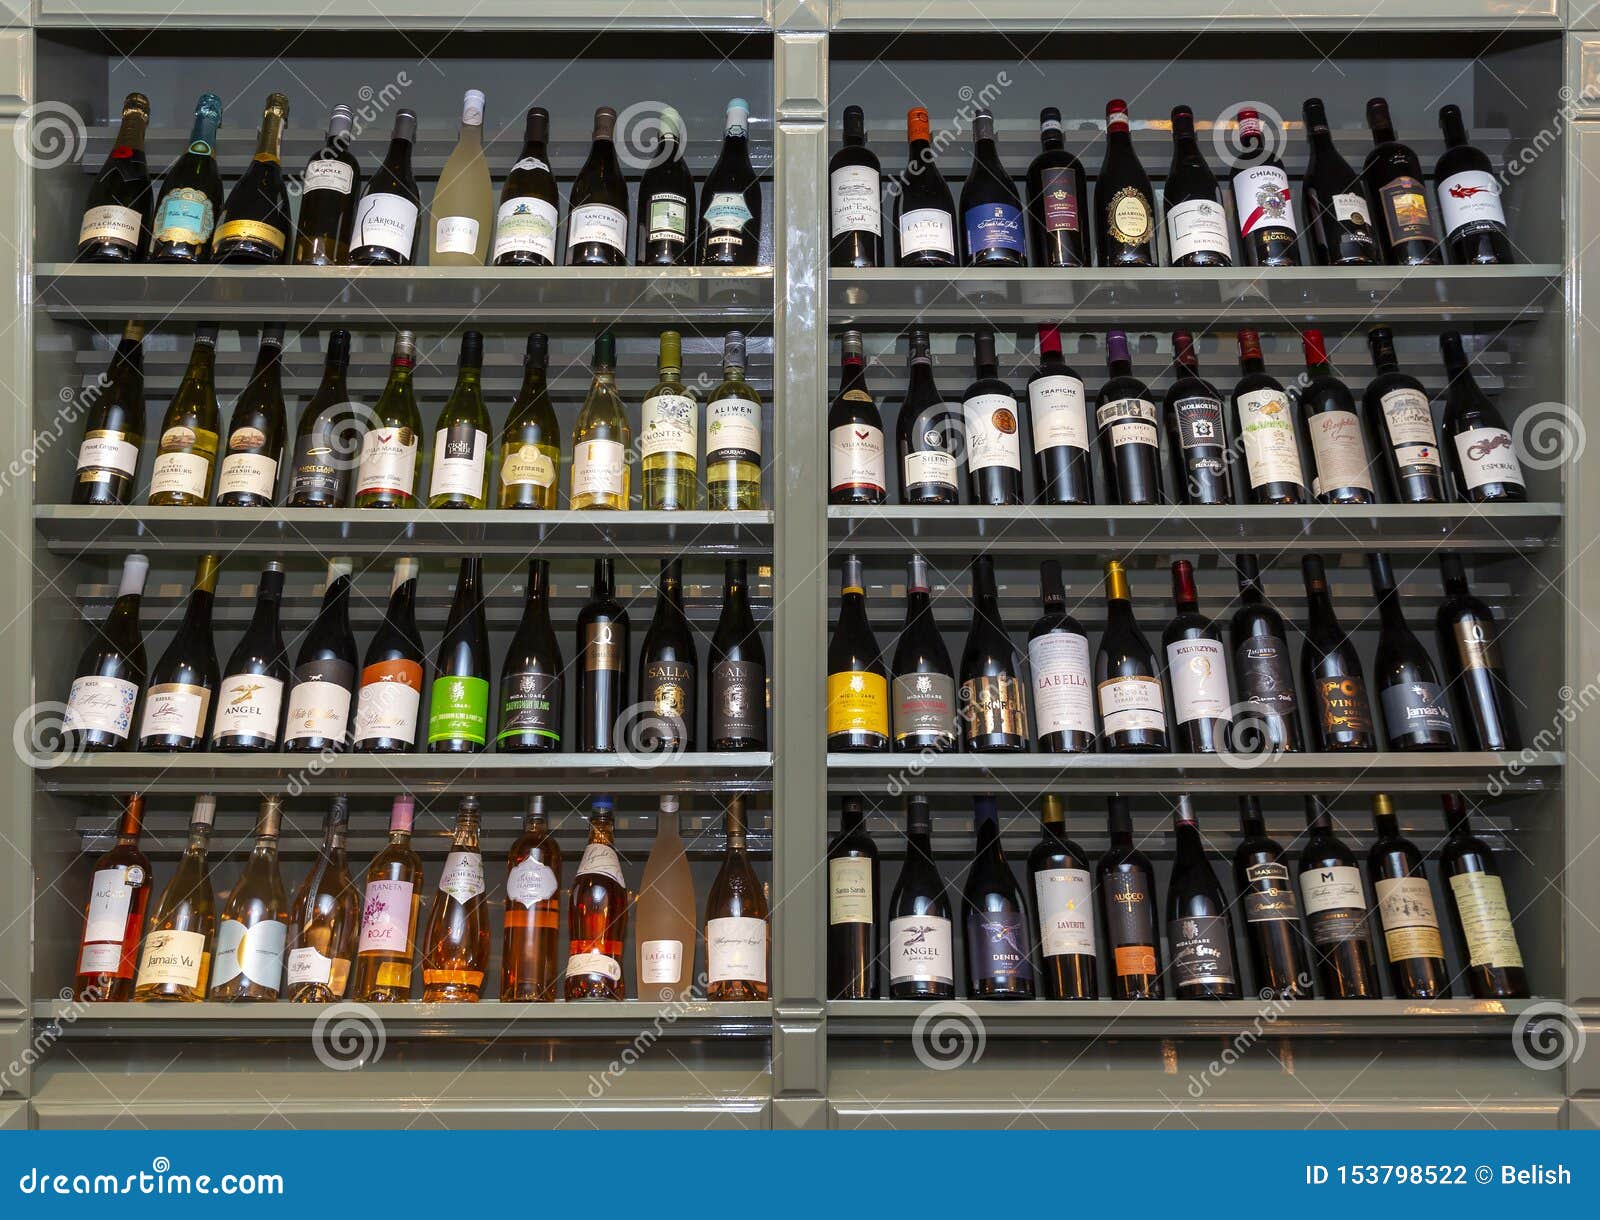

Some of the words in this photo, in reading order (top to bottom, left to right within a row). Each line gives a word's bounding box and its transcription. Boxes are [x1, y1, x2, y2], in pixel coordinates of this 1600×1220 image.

[1249, 170, 1284, 180] CHIANTI
[102, 221, 135, 231] CHANDON
[1040, 388, 1077, 396] TRAPICHE
[715, 406, 753, 415] ALIWEN
[647, 430, 682, 440] MONTES
[648, 666, 690, 679] SALLA
[1038, 677, 1052, 690] LA
[1054, 674, 1089, 688] BELLA
[224, 705, 262, 716] ANGEL
[1406, 706, 1438, 719] Jamais
[1321, 871, 1335, 883] M
[367, 928, 393, 938] ROSÉ
[902, 946, 940, 956] ANGEL
[147, 954, 178, 968] Jamais
[180, 954, 194, 967] Vu
